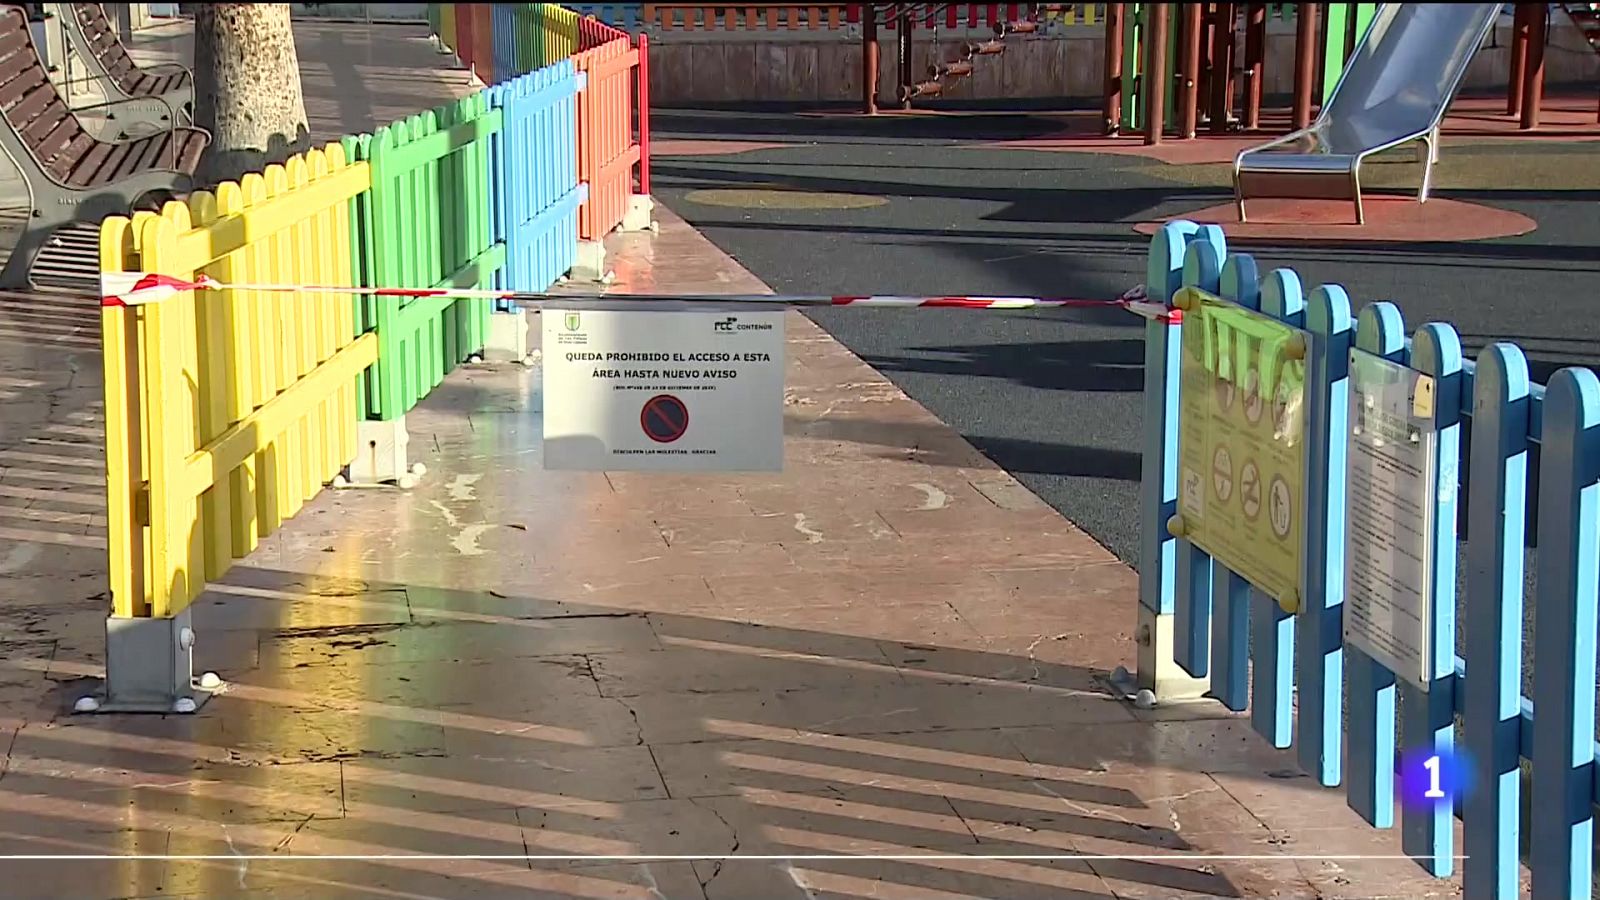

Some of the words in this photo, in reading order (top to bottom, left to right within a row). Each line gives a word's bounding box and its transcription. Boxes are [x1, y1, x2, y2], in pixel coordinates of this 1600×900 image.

[565, 352, 603, 362] QUEDA
[606, 352, 670, 362] PROHIBIDO
[673, 353, 686, 362] EL
[688, 352, 730, 362] ACCESO
[733, 353, 741, 362] A
[743, 353, 770, 362] ESTA
[592, 367, 621, 378] ÁREA
[624, 369, 660, 378] HASTA
[662, 369, 700, 379] NUEVO
[702, 369, 737, 379] AVISO
